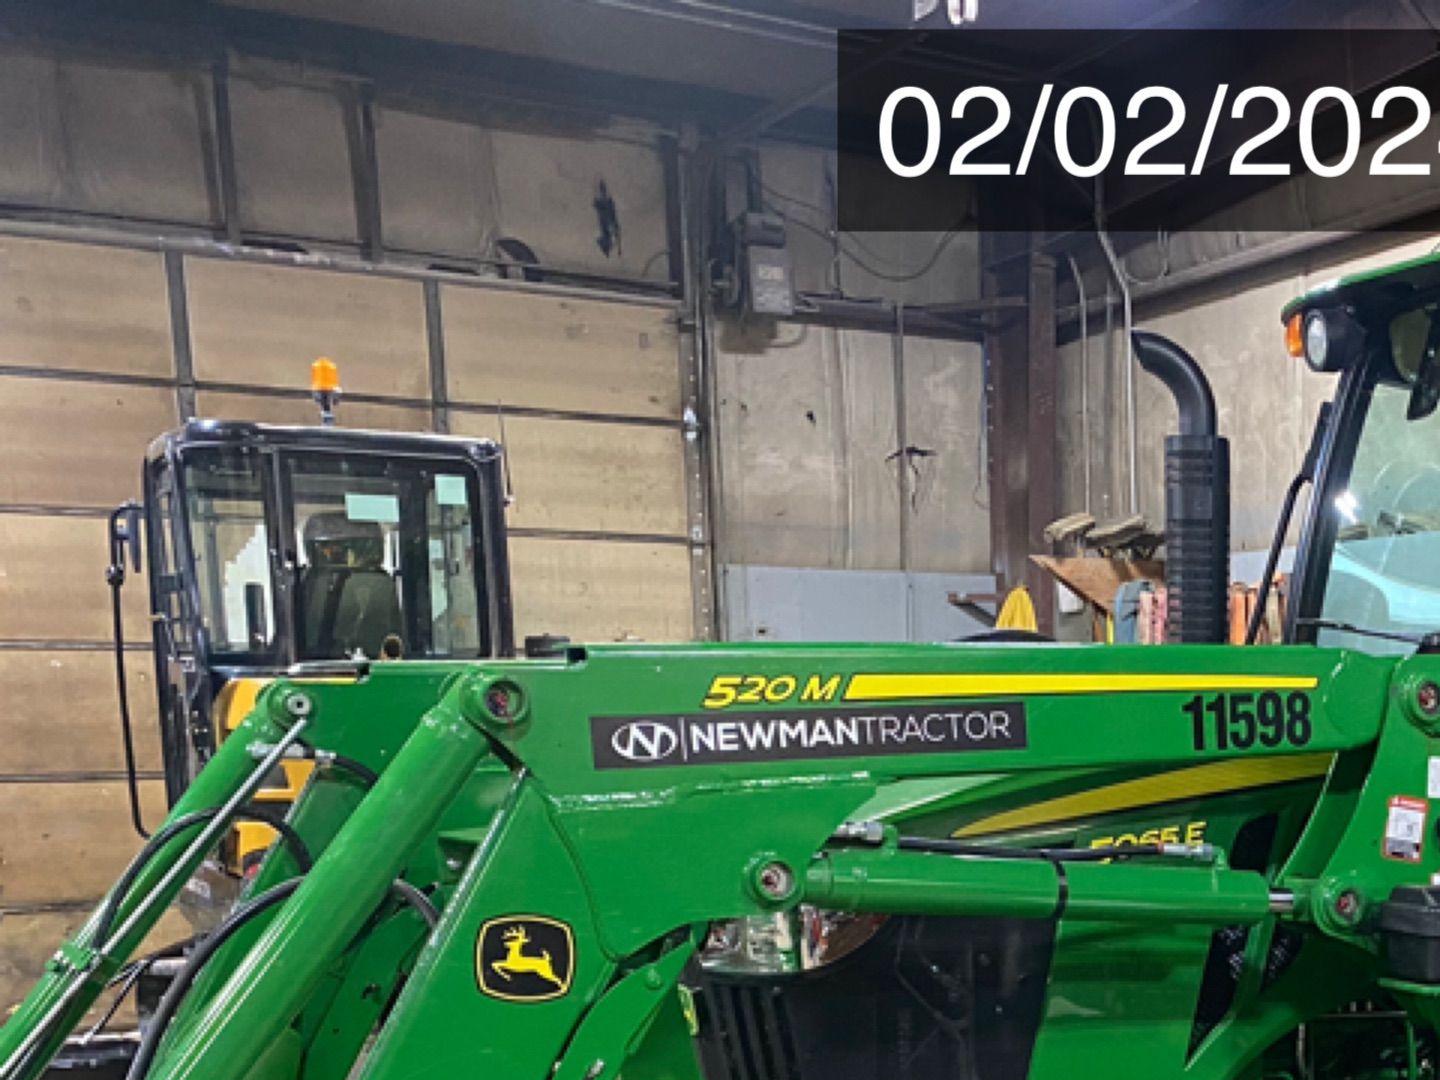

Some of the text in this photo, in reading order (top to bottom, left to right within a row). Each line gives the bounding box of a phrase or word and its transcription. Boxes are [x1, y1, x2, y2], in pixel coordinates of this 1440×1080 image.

[703, 674, 841, 709] 520 M
[689, 710, 1012, 753] NEWMANTRACTOR
[1182, 690, 1312, 751] 11598
[1184, 821, 1207, 848] E
